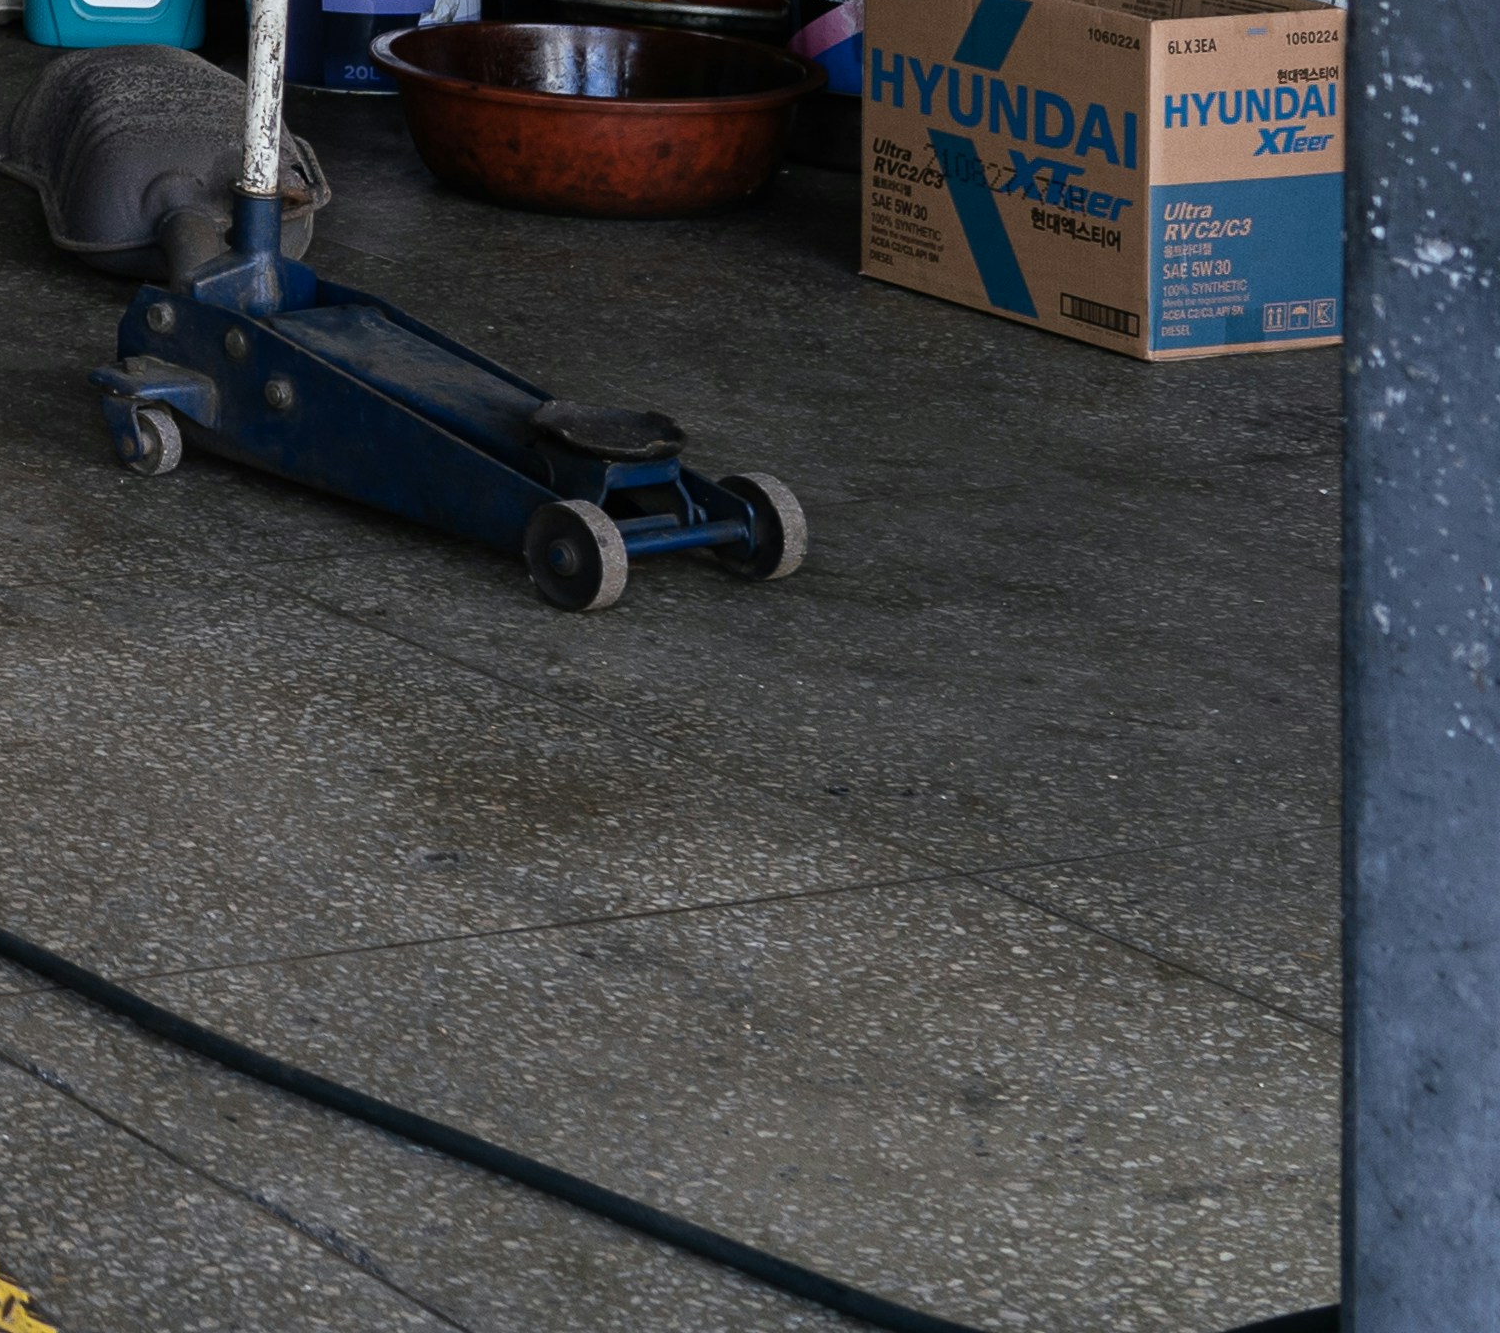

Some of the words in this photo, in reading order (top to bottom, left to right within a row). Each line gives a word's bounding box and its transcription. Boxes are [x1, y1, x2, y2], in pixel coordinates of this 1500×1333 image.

[1087, 27, 1141, 51] 1060224
[1285, 30, 1339, 47] 1060224
[343, 62, 381, 81] 20L
[1276, 65, 1339, 85] 현대엑스티어
[870, 48, 1138, 171] HYUNDAI
[1163, 83, 1337, 130] HYUNDAI
[872, 137, 912, 164] Ultra
[1253, 126, 1334, 157] XTeer
[1000, 148, 1133, 223] XTeer
[871, 192, 893, 213] SAE
[1163, 202, 1214, 221] Ultra
[893, 217, 943, 242] SYNTHETIC
[1031, 207, 1122, 253] 현대엑스티어
[1162, 262, 1188, 280] SAE
[1190, 279, 1248, 295] SYNTHETIC
